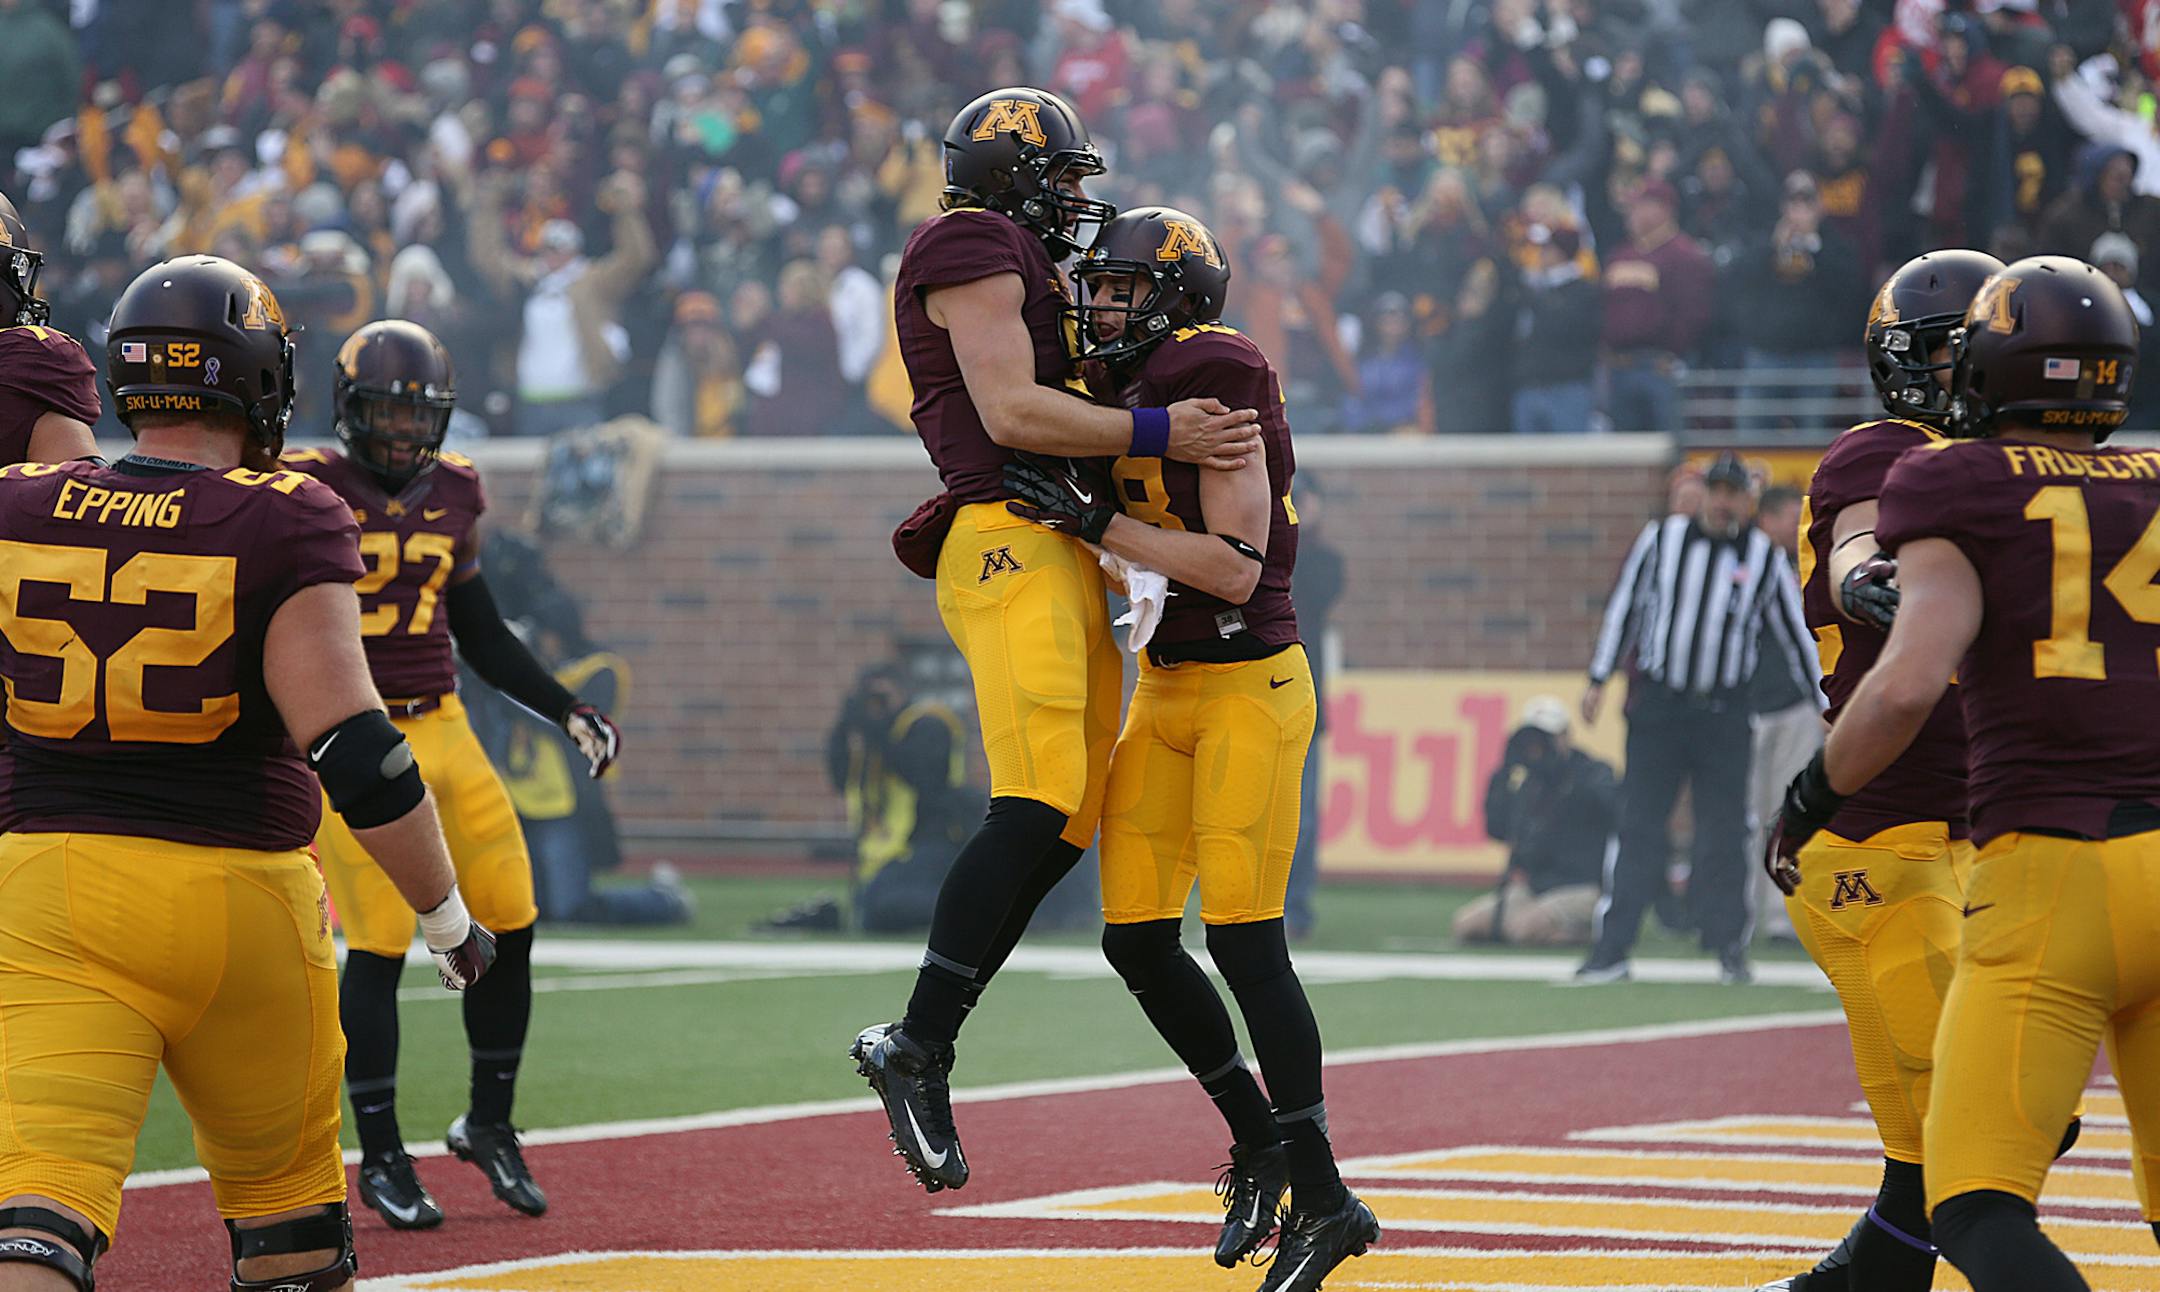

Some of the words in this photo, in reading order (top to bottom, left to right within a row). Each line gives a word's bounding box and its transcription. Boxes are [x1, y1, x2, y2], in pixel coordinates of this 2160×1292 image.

[973, 100, 1047, 147] M
[1157, 220, 1221, 269] M
[167, 343, 200, 367] 52
[2096, 359, 2118, 385] 14
[126, 396, 200, 410] SKI-U-MAH
[146, 456, 196, 469] COMBAT
[53, 478, 185, 529] EPPING
[352, 531, 456, 637] 27
[976, 544, 1025, 586] M
[0, 540, 240, 744] 52
[1827, 868, 1886, 911] M
